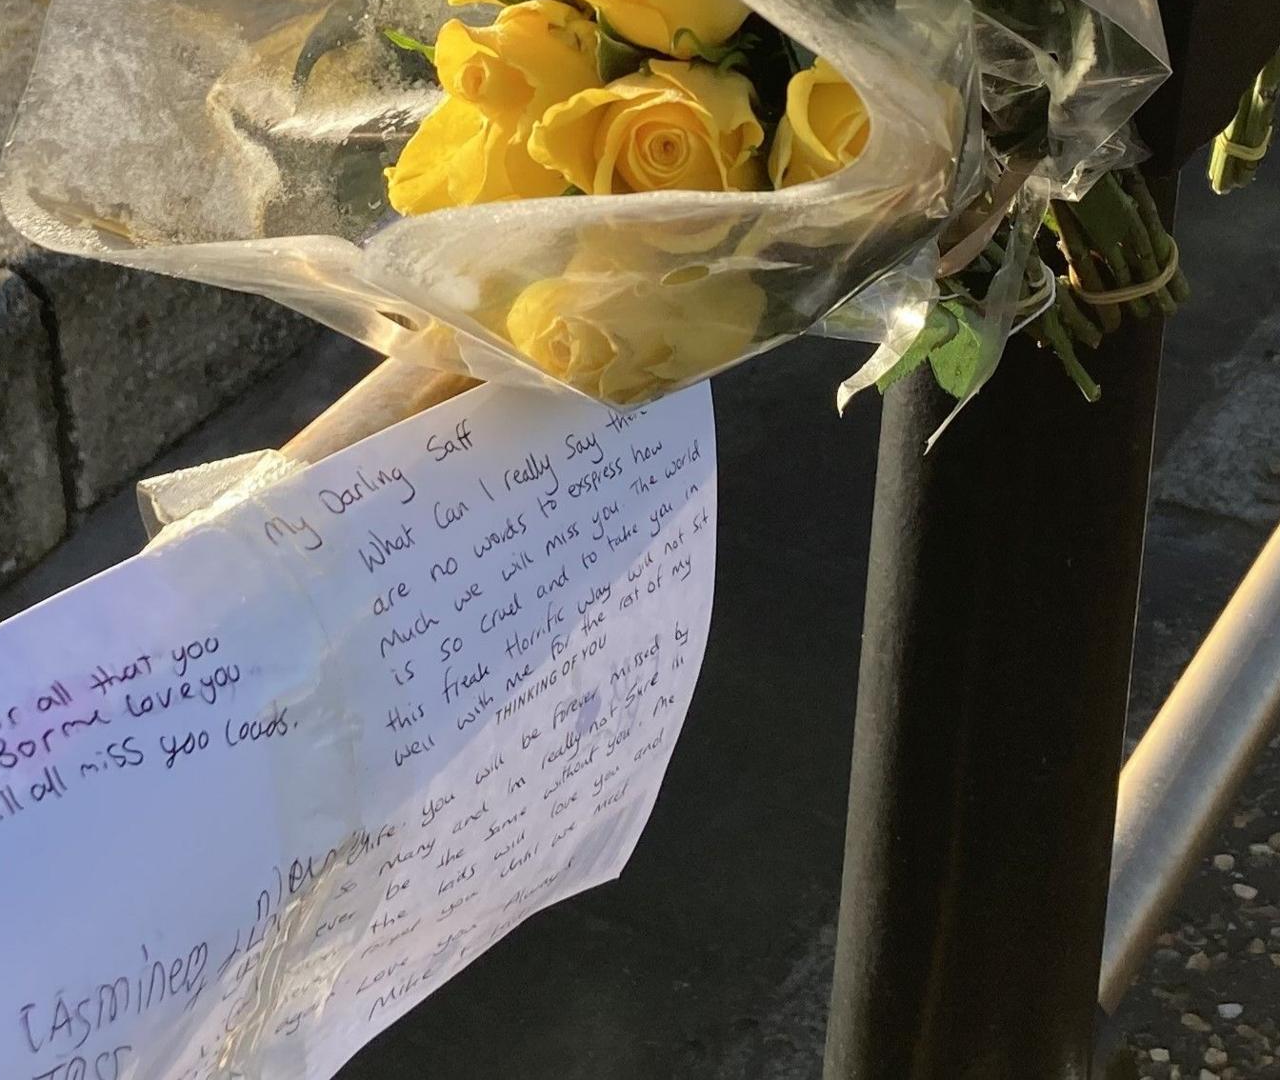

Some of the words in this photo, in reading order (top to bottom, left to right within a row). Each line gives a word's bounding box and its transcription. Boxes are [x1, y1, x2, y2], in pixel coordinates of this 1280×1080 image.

[264, 515, 323, 551] My
[319, 467, 416, 515] Darling
[427, 418, 474, 462] Saff
[358, 523, 417, 574] What
[434, 501, 470, 530] Can
[479, 478, 495, 502] I
[504, 452, 560, 497] really
[373, 582, 411, 616] are
[430, 557, 459, 583] no
[474, 514, 528, 559] words
[537, 497, 559, 519] to
[631, 441, 664, 465] how
[455, 583, 483, 612] we
[502, 550, 535, 583] will
[546, 522, 581, 557] miss
[631, 474, 658, 497] The
[665, 439, 702, 481] world
[385, 703, 425, 733] this
[442, 662, 490, 704] freak
[578, 582, 612, 615] way
[627, 552, 655, 583] will
[664, 530, 685, 556] not
[392, 660, 415, 687] is
[481, 592, 523, 635] cruel
[537, 564, 570, 600] and
[581, 551, 598, 570] to
[607, 523, 639, 553] take
[650, 503, 674, 538] you
[685, 484, 700, 500] in
[457, 691, 495, 731] with
[581, 611, 607, 638] the
[620, 589, 640, 612] rest
[647, 563, 664, 595] of
[37, 679, 73, 712] all
[90, 655, 152, 695] that
[172, 637, 220, 677] you
[200, 664, 241, 705] you
[475, 751, 505, 785] will
[522, 728, 543, 751] be
[610, 633, 662, 686] missed
[674, 620, 690, 646] by
[495, 672, 558, 727] THINKING
[562, 654, 578, 677] OF
[581, 633, 608, 661] YOU
[30, 766, 69, 802] all
[370, 909, 408, 935] the
[438, 865, 476, 897] lads
[493, 829, 527, 862] will
[550, 791, 579, 820] love
[592, 765, 621, 798] you
[634, 727, 666, 762] and
[385, 879, 411, 901] be
[436, 847, 467, 870] the
[484, 805, 528, 842] same
[543, 745, 601, 801] without
[452, 800, 490, 835] and
[541, 732, 582, 770] really
[589, 704, 620, 736] not
[369, 968, 435, 1021] Mike
